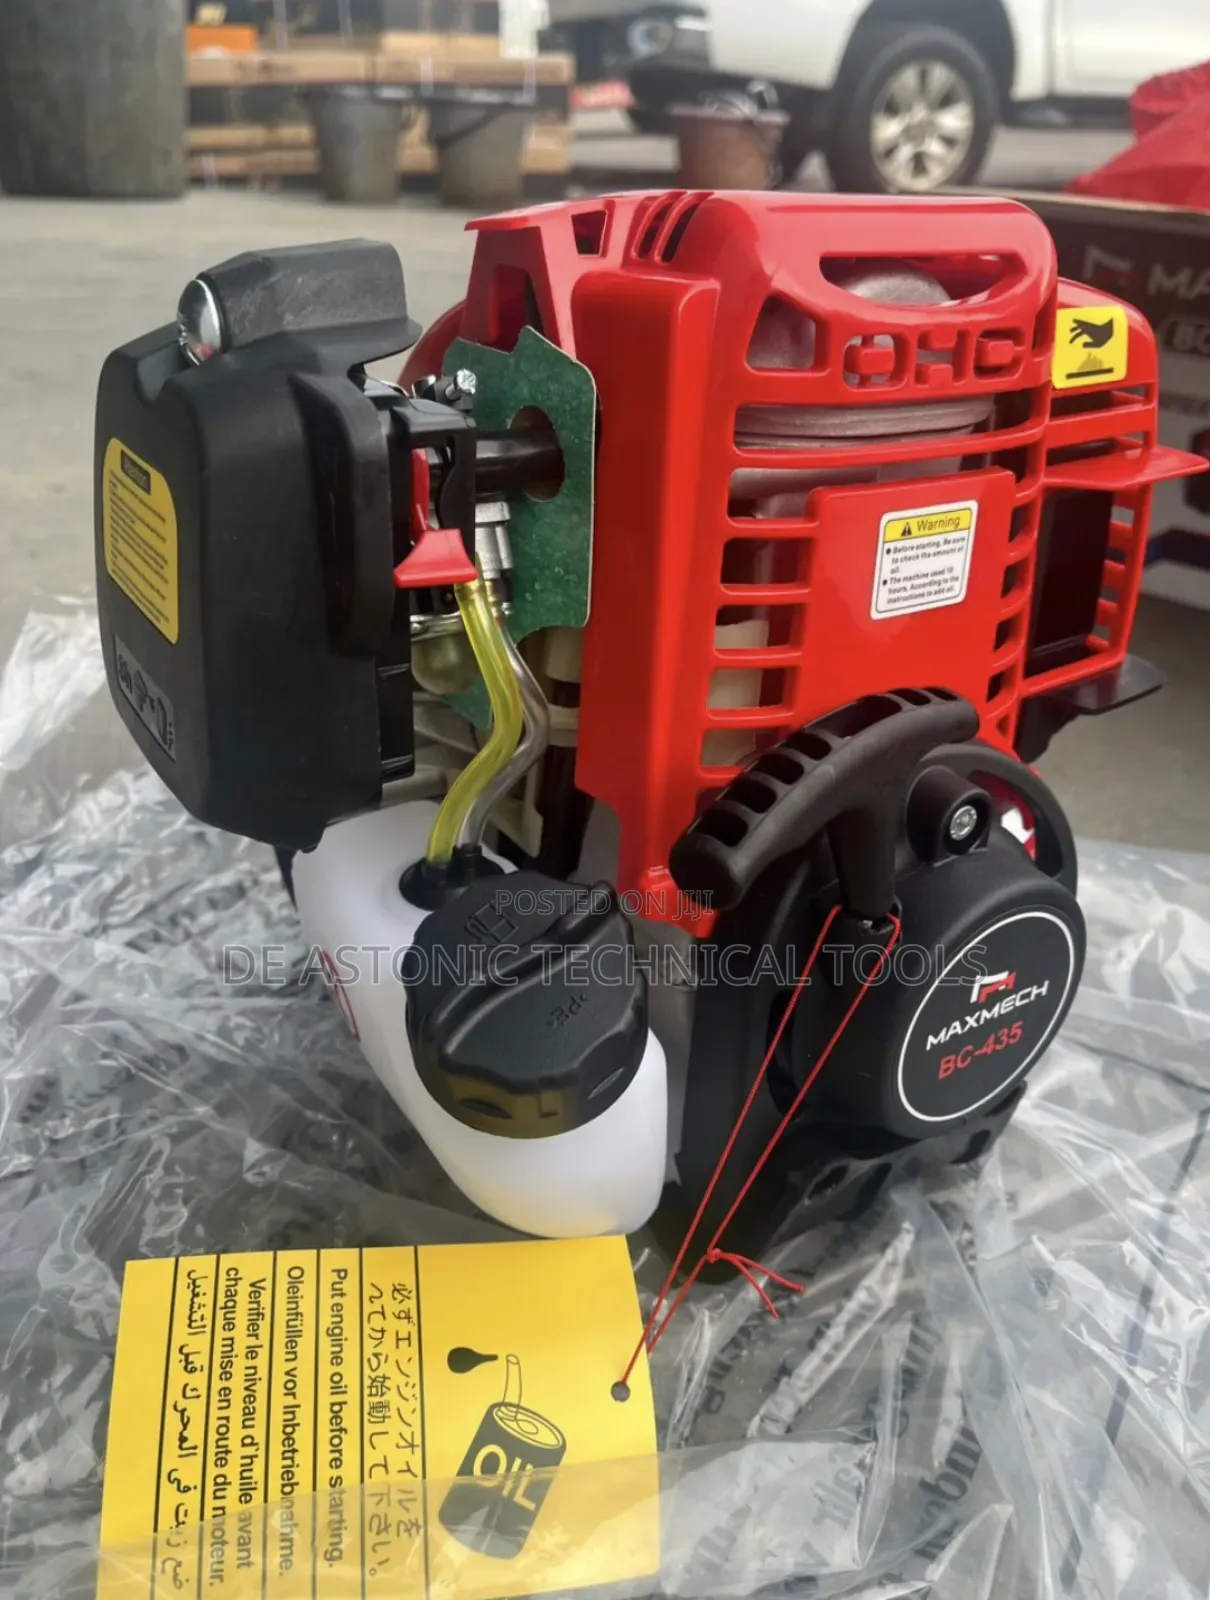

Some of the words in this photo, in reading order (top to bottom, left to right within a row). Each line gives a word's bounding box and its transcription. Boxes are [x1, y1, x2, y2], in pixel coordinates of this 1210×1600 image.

[893, 544, 914, 555] Before
[917, 516, 960, 532] Warning
[890, 576, 901, 585] The
[902, 572, 929, 581] machine
[930, 569, 945, 577] used
[900, 553, 919, 563] check
[921, 551, 931, 559] the
[932, 548, 956, 557] amount
[910, 580, 941, 590] According
[933, 587, 946, 595] add
[926, 980, 1049, 1051] MAXMECH
[938, 1020, 1024, 1080] BC-435
[187, 1269, 208, 1336] التشغيل
[219, 1267, 238, 1332] chaque
[331, 1268, 348, 1298] Put
[245, 1278, 266, 1341] Verifier
[283, 1266, 304, 1366] Oleinfüllen
[326, 1302, 347, 1367] engine
[178, 1343, 203, 1375] قبل
[220, 1336, 236, 1381] mise
[245, 1344, 262, 1361] le
[217, 1386, 232, 1411] en
[242, 1364, 261, 1429] niveau
[283, 1367, 297, 1398] vor
[330, 1372, 347, 1396] oil
[173, 1383, 200, 1459] المحرك
[329, 1401, 347, 1469] before
[392, 1283, 421, 1538] 必ずエンジンオイルを
[215, 1416, 230, 1468] route
[213, 1473, 232, 1500] du
[473, 1444, 536, 1511] OIL
[236, 1510, 254, 1568] avant
[324, 1473, 345, 1568] starting.
